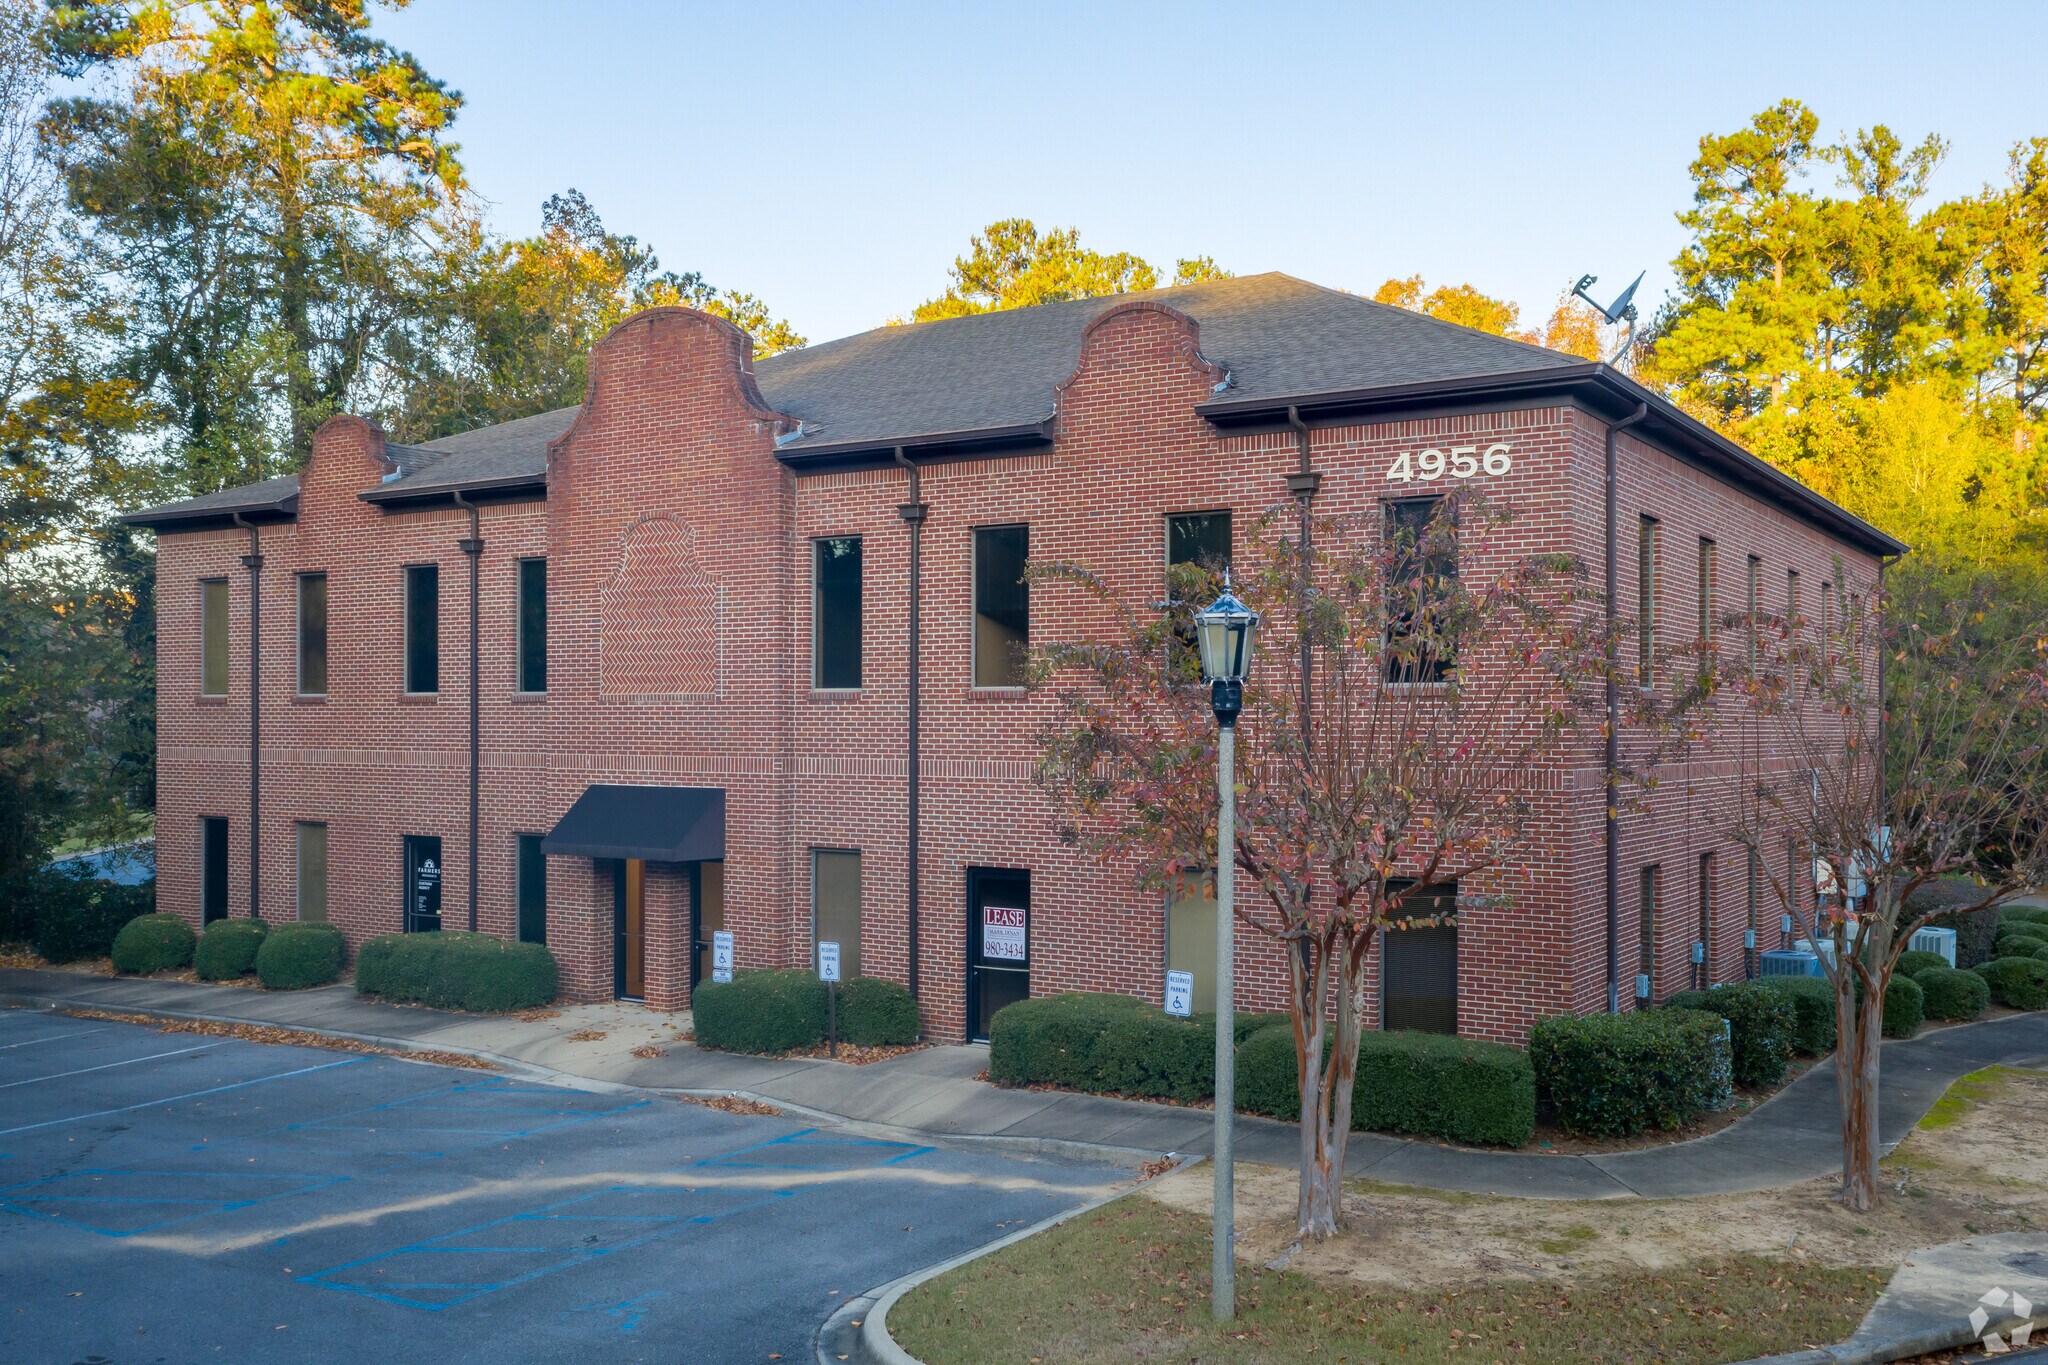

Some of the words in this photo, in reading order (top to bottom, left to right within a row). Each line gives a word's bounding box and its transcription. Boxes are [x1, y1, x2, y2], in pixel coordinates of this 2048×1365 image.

[1386, 443, 1512, 483] 4956
[986, 909, 1024, 927] LEASE
[985, 940, 1024, 959] 980-3434
[1170, 976, 1190, 984] RESERVED
[1170, 986, 1188, 994] PARKING
